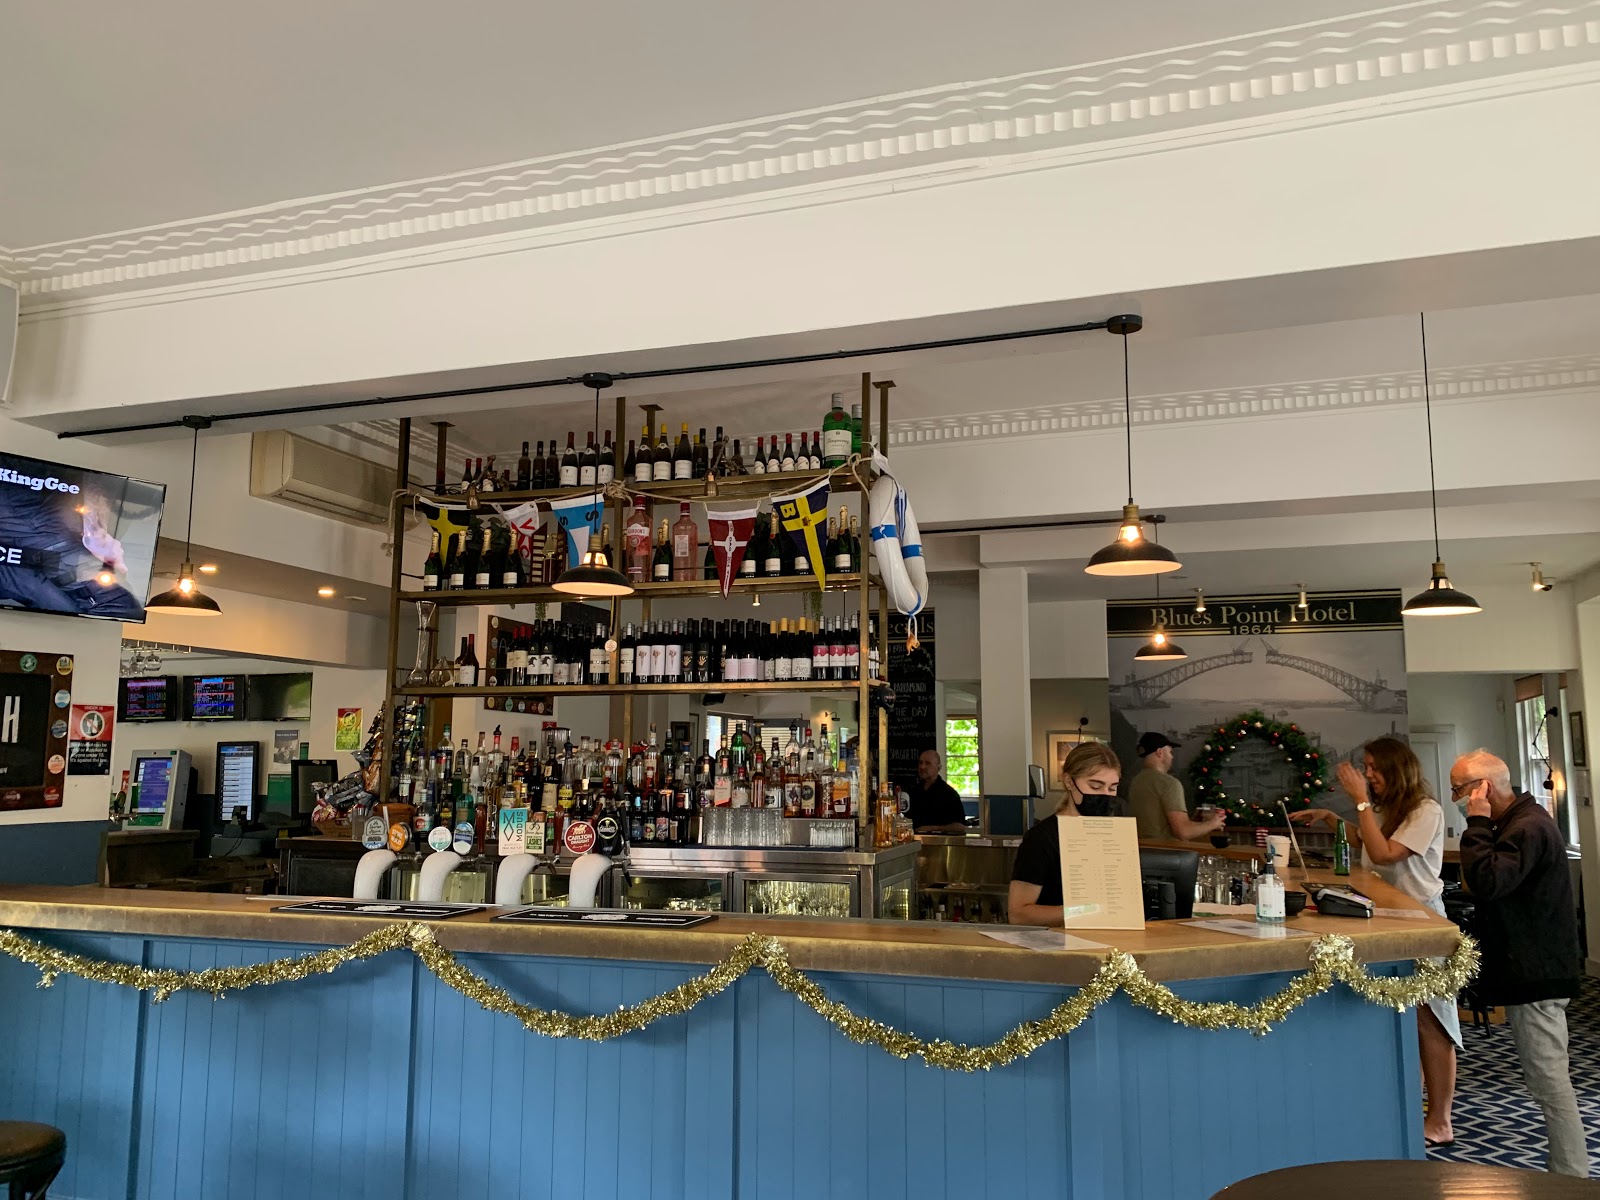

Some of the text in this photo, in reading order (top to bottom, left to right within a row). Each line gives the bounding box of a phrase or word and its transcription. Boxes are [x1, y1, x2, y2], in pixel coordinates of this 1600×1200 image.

[0, 467, 80, 495] KingGee
[1151, 602, 1356, 627] Blues Point Hotel
[1232, 625, 1273, 635] 1864
[911, 706, 928, 717] DAY
[516, 811, 524, 842] MODUS
